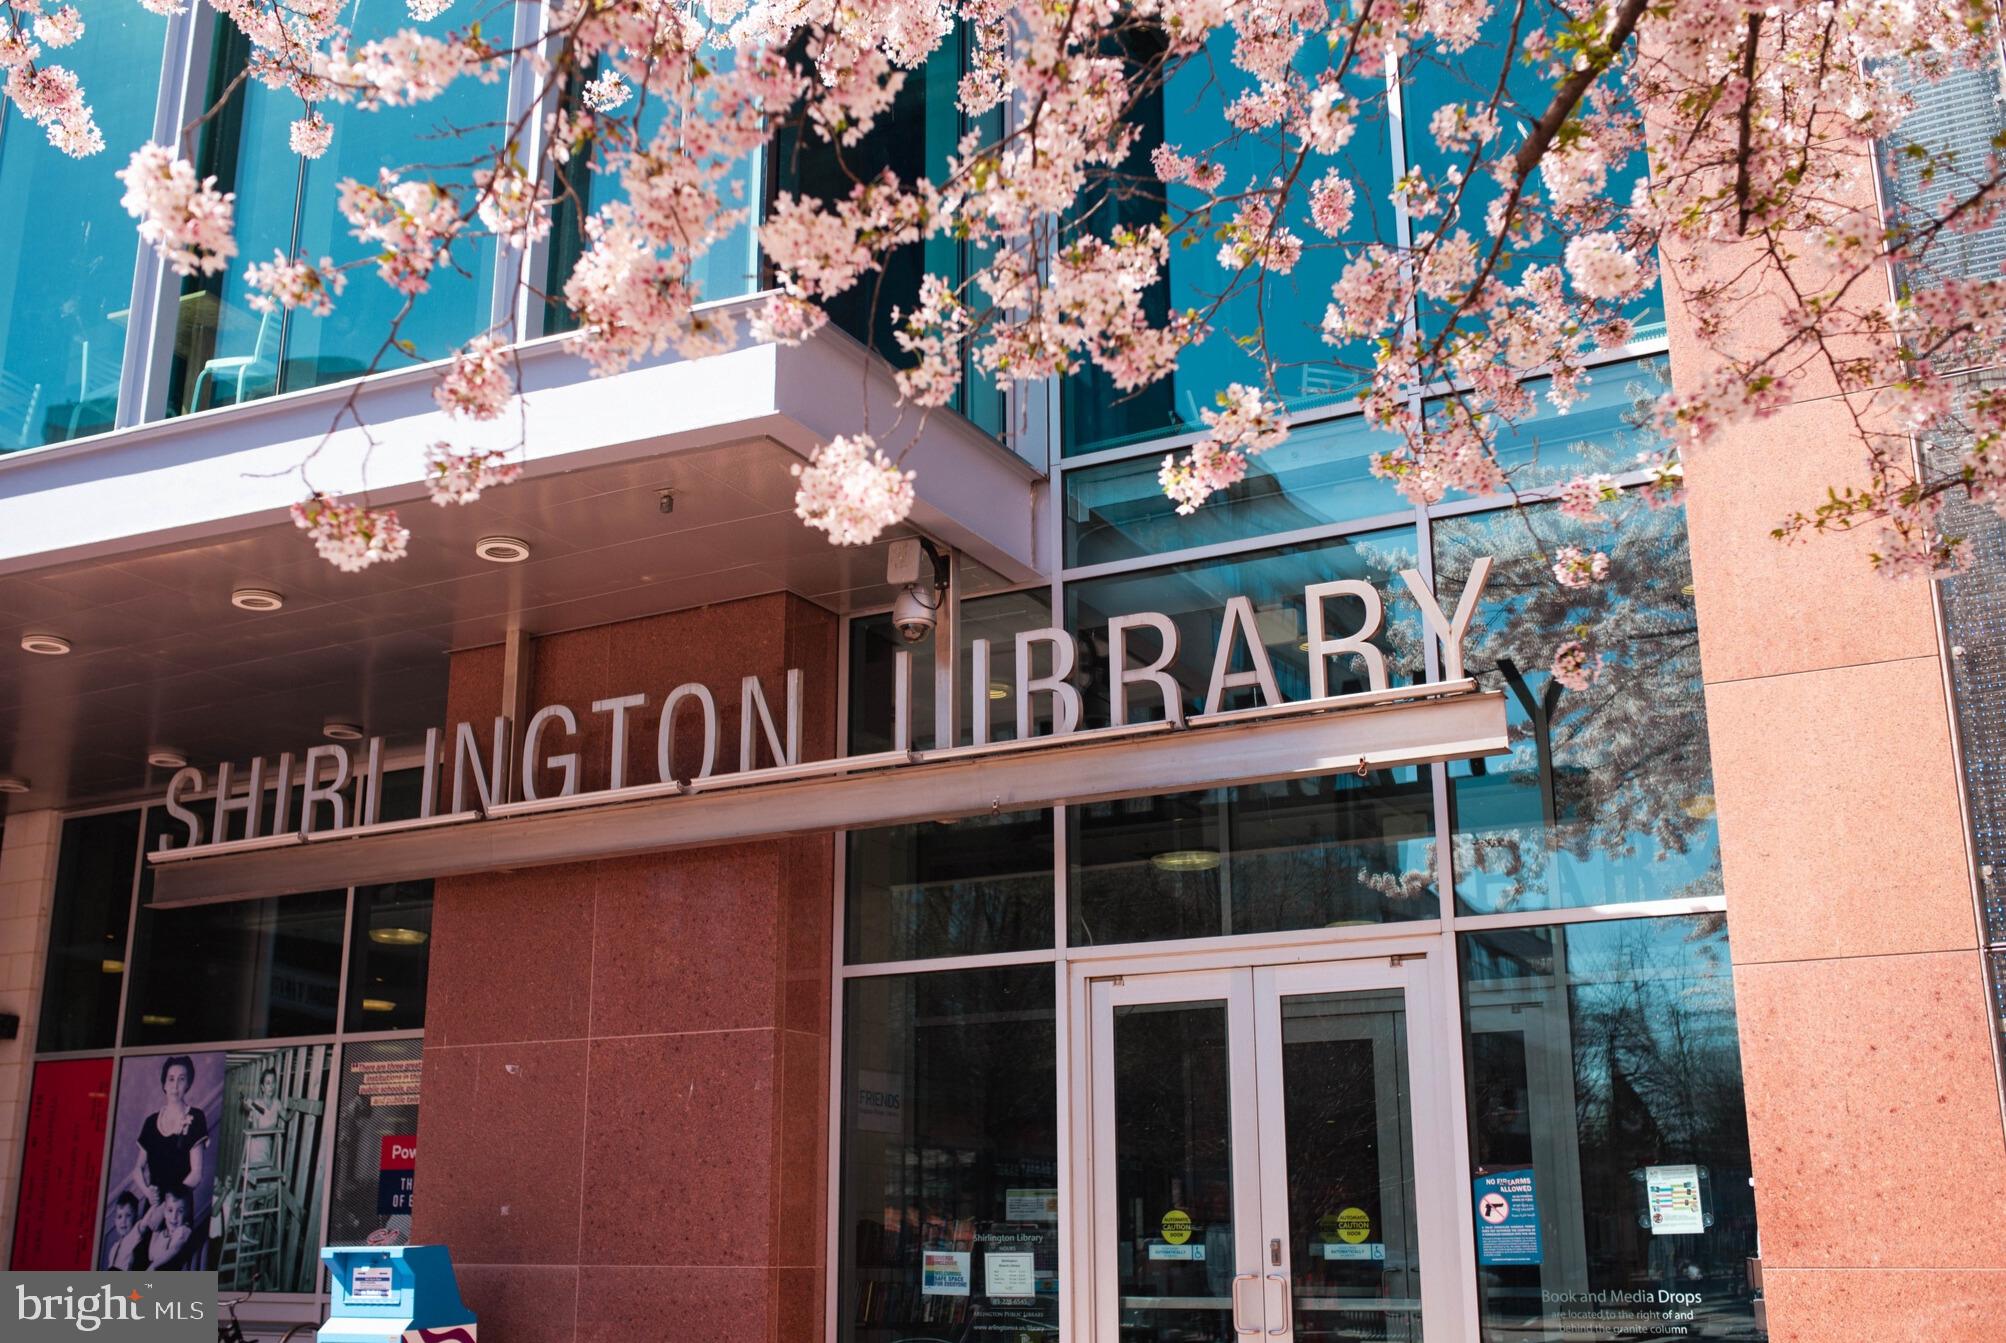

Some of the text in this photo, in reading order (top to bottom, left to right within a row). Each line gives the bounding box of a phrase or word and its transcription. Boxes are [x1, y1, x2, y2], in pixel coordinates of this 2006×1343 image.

[159, 555, 1494, 852] SHIRLINGTON LIBRARY
[860, 1089, 900, 1109] FRIENDS
[1500, 1185, 1532, 1193] ALLOWED
[392, 1194, 405, 1208] OF
[974, 1234, 1044, 1244] Shirlington Library
[1541, 1290, 1702, 1306] Book and Media Drops
[1552, 1310, 1694, 1322] are located to the right of and
[1613, 1325, 1648, 1336] granite
[1650, 1325, 1688, 1334] column
